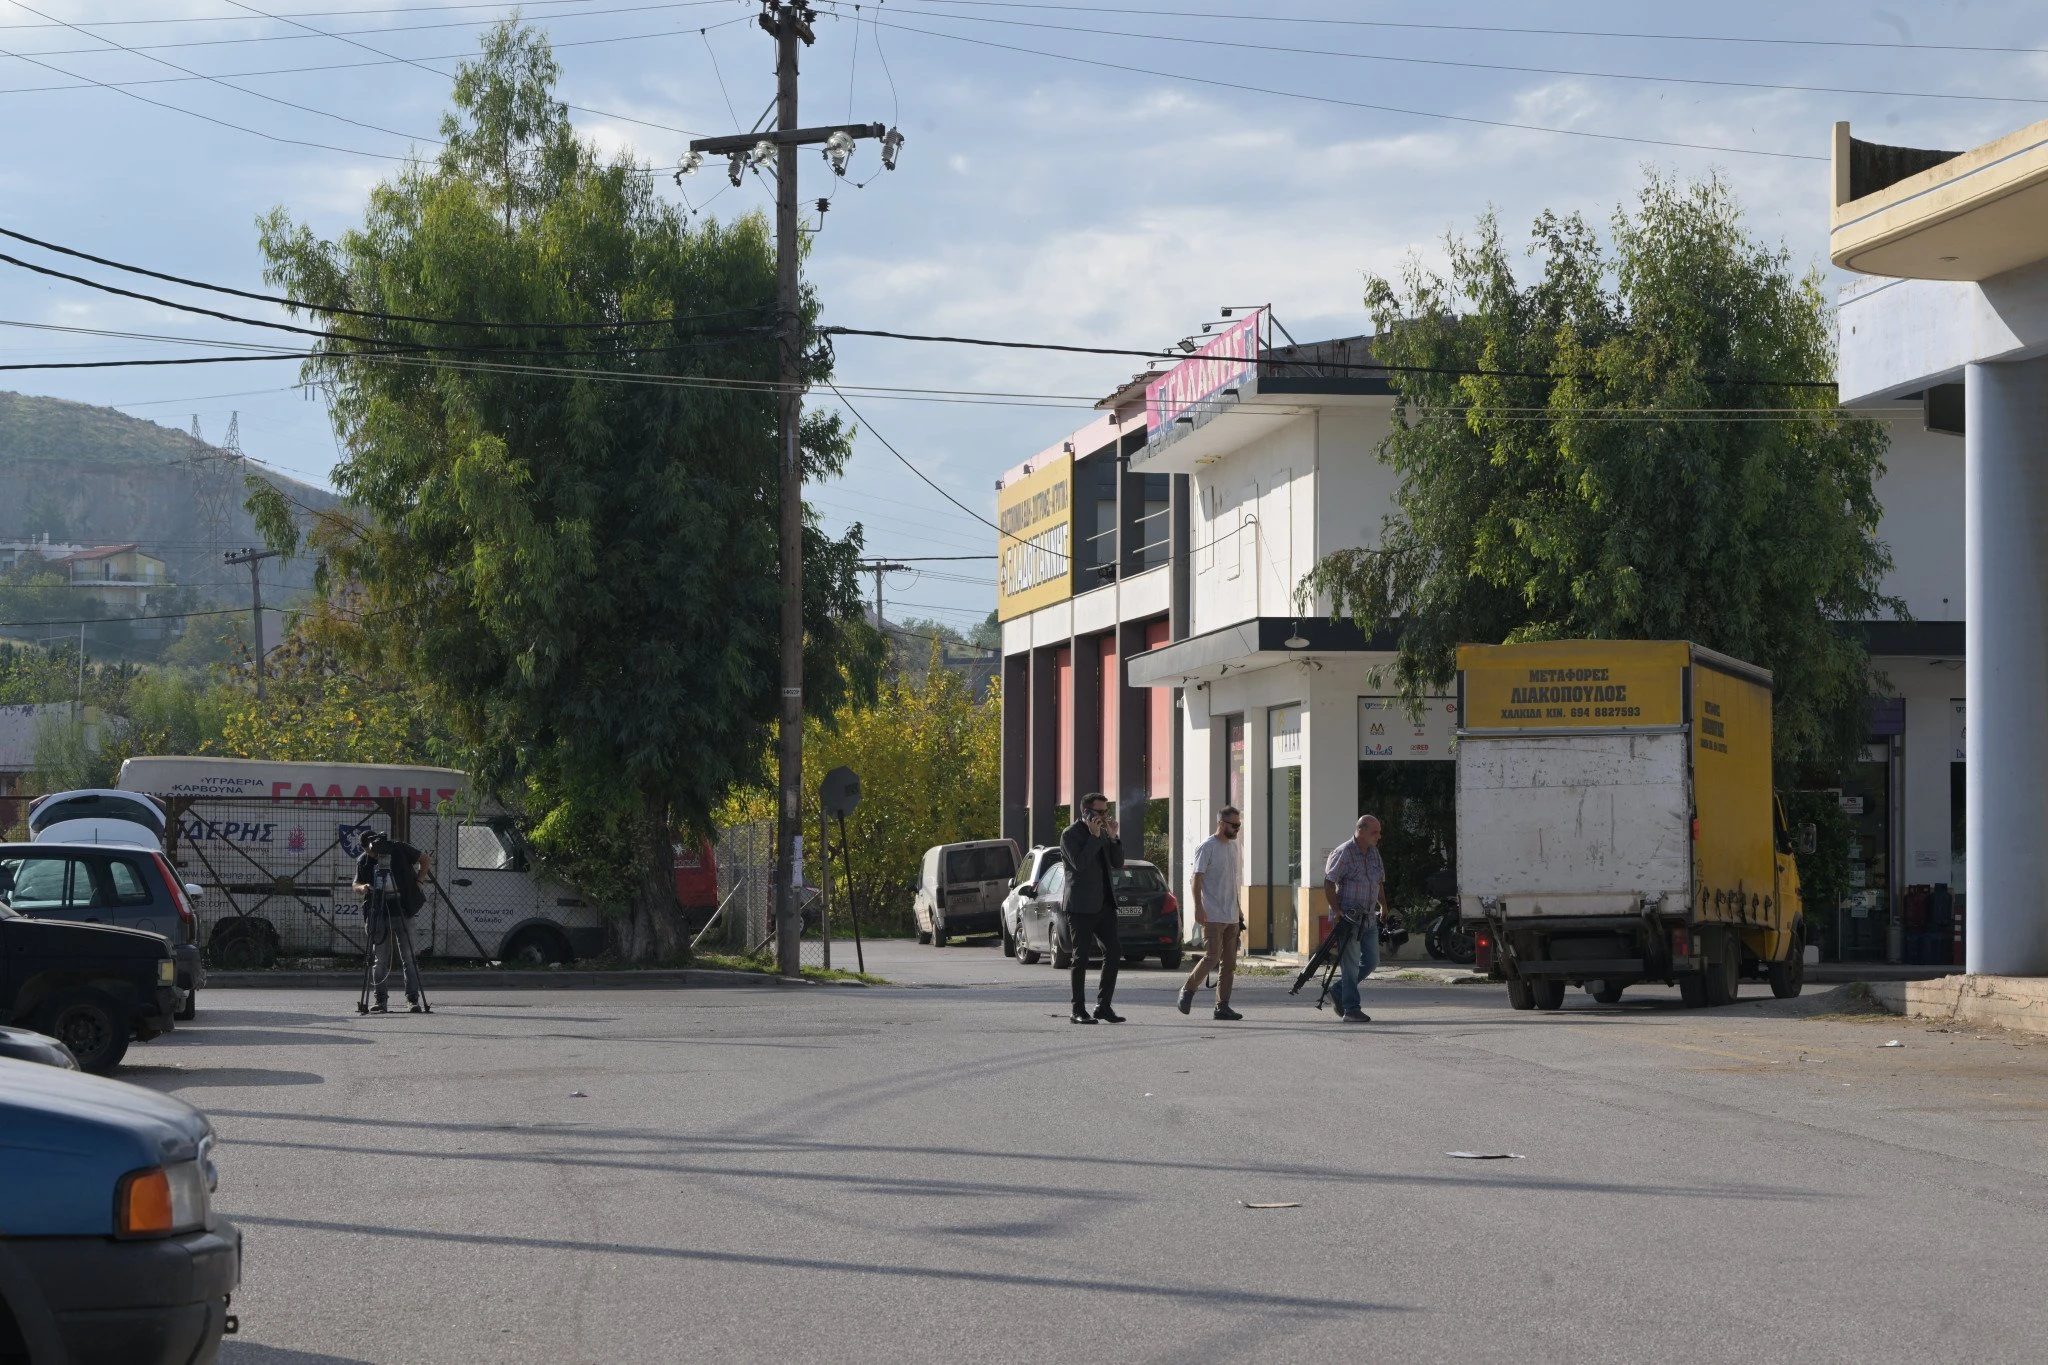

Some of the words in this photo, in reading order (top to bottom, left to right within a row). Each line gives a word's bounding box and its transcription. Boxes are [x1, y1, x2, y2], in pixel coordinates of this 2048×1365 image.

[1529, 668, 1608, 682] ΜΕΤΑΦΟΡΕΣ
[1511, 685, 1626, 704] ΛΙΑΚΟΠΟΥΛΟΣ
[1501, 708, 1542, 719] ΧΑΛΚΙΔΑ
[1546, 707, 1566, 718] ΚΙΝ.
[205, 777, 264, 787] ΥΓΡΑΕΡΙΑ
[174, 784, 243, 794] ΚΑΡΒΟΥΝΑ
[165, 820, 278, 842] ΙΔΕΡΗΣ
